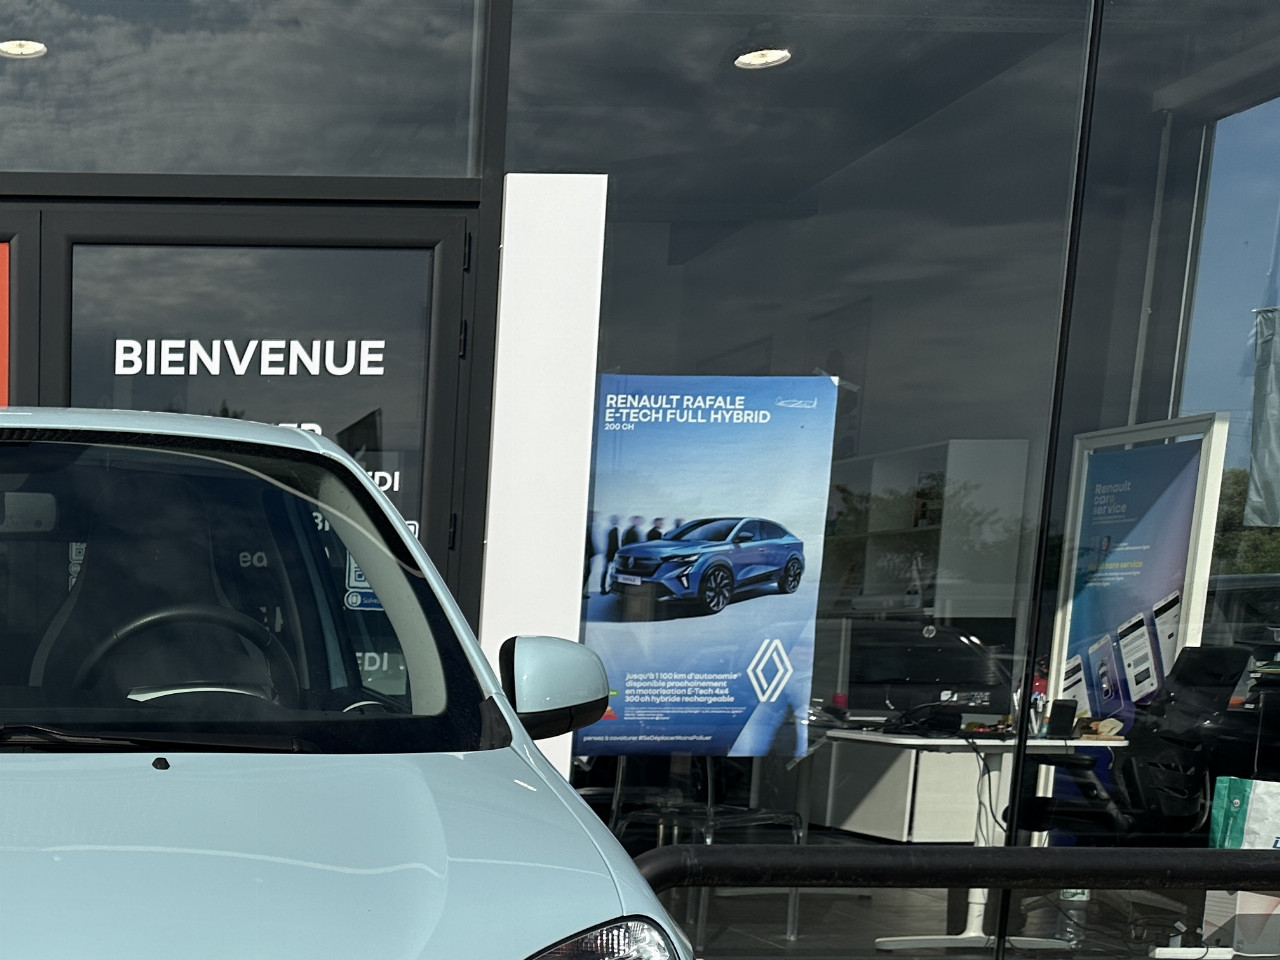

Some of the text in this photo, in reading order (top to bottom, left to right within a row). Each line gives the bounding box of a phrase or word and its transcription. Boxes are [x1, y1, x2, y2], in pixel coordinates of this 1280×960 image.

[114, 339, 385, 376] BIENVENUE
[606, 394, 745, 409] RENAULT RAFALE
[605, 409, 771, 423] E-TECH FULL HYBRID
[605, 423, 635, 431] 200 CH
[625, 672, 654, 681] jusqu'à
[674, 672, 686, 680] km
[625, 680, 665, 688] disponible
[636, 687, 686, 695] motorisation
[651, 695, 681, 704] hybride
[682, 695, 735, 704] rechargeable
